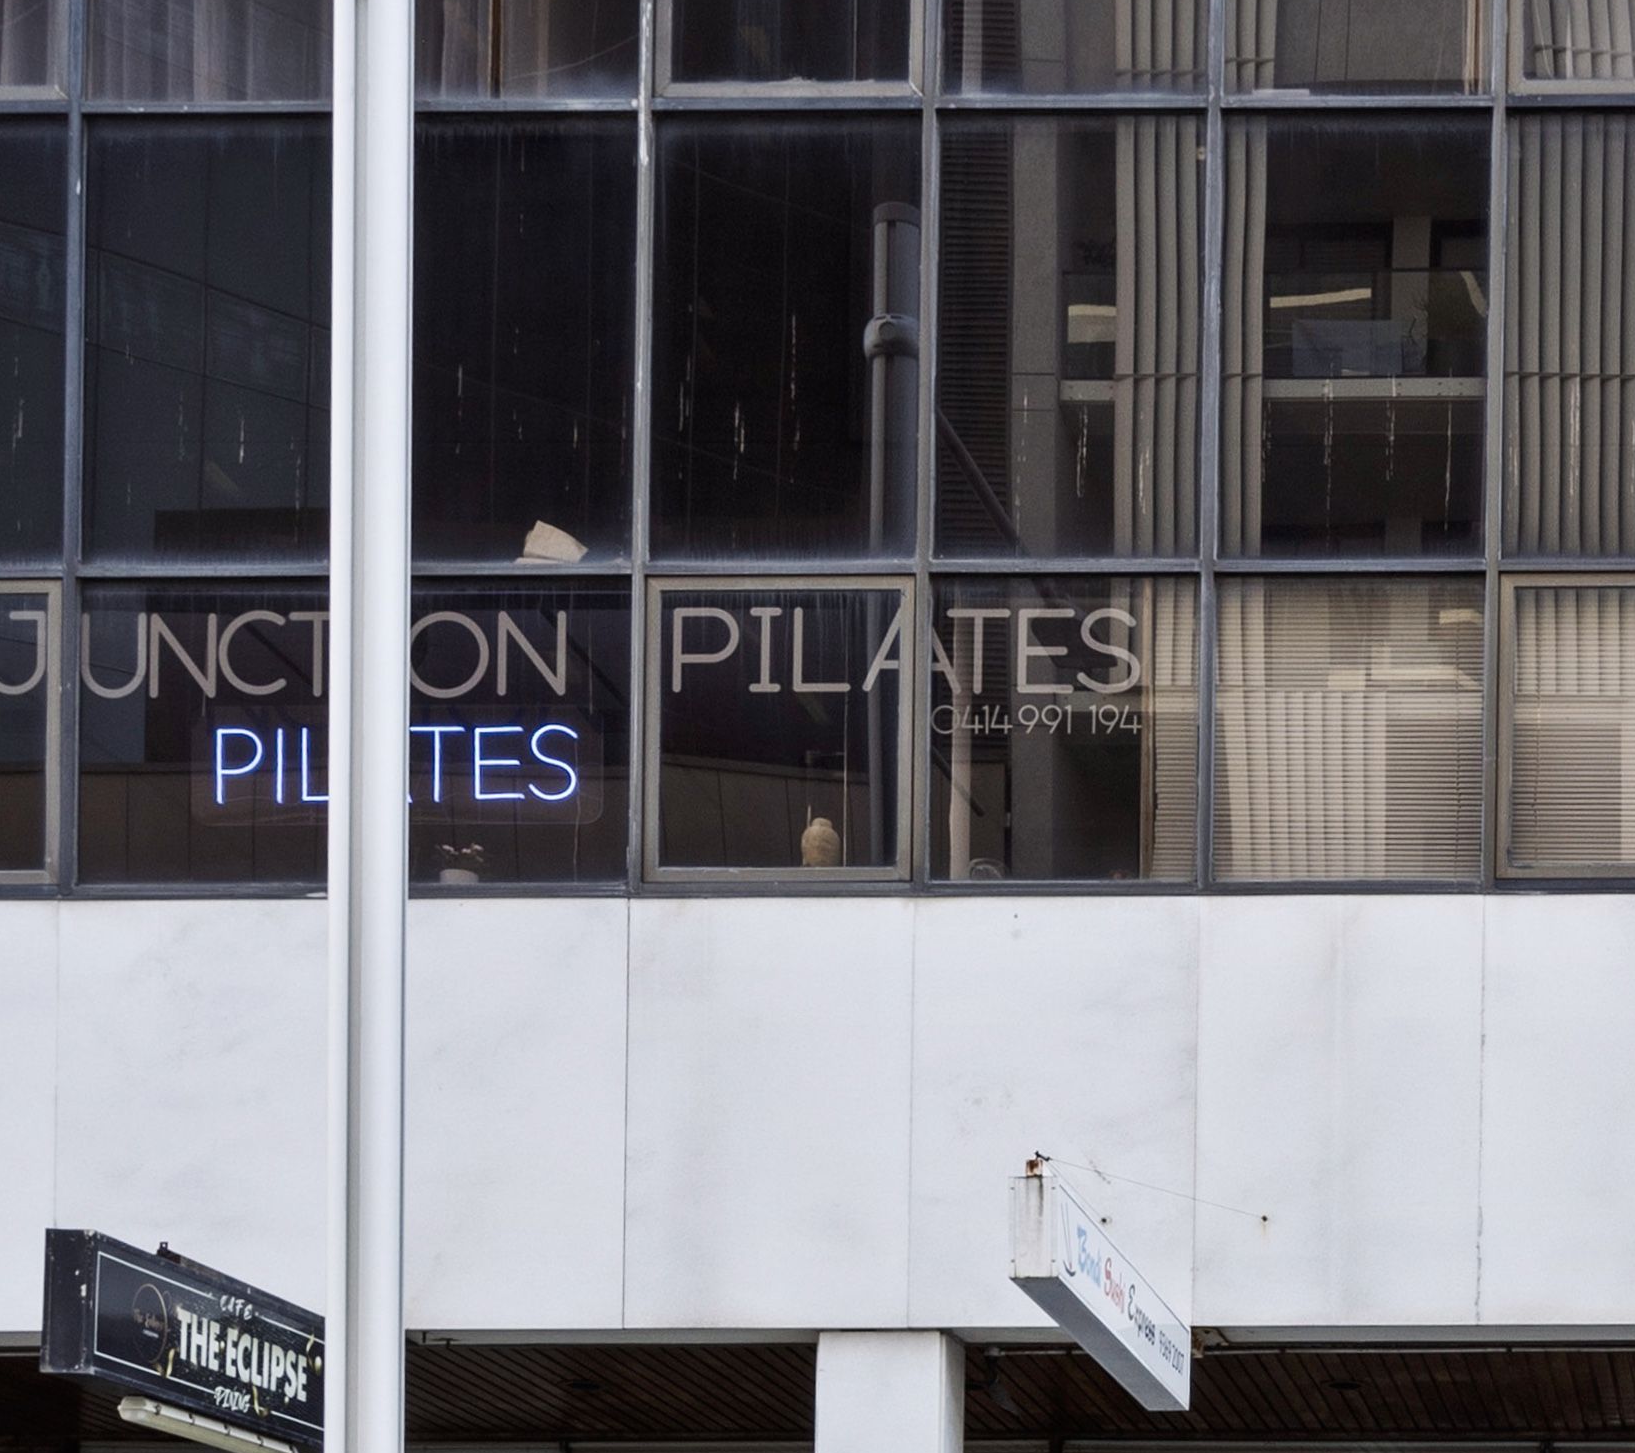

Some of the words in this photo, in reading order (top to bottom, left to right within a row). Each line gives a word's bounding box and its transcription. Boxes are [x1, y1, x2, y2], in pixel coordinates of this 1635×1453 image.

[672, 607, 1142, 695] PILATES
[931, 704, 1014, 736] 0414
[1017, 704, 1071, 736] 991
[1088, 704, 1142, 735] 194
[215, 723, 580, 805] PILTES
[176, 1304, 221, 1372] THE
[225, 1326, 308, 1403] ECLIPSE
